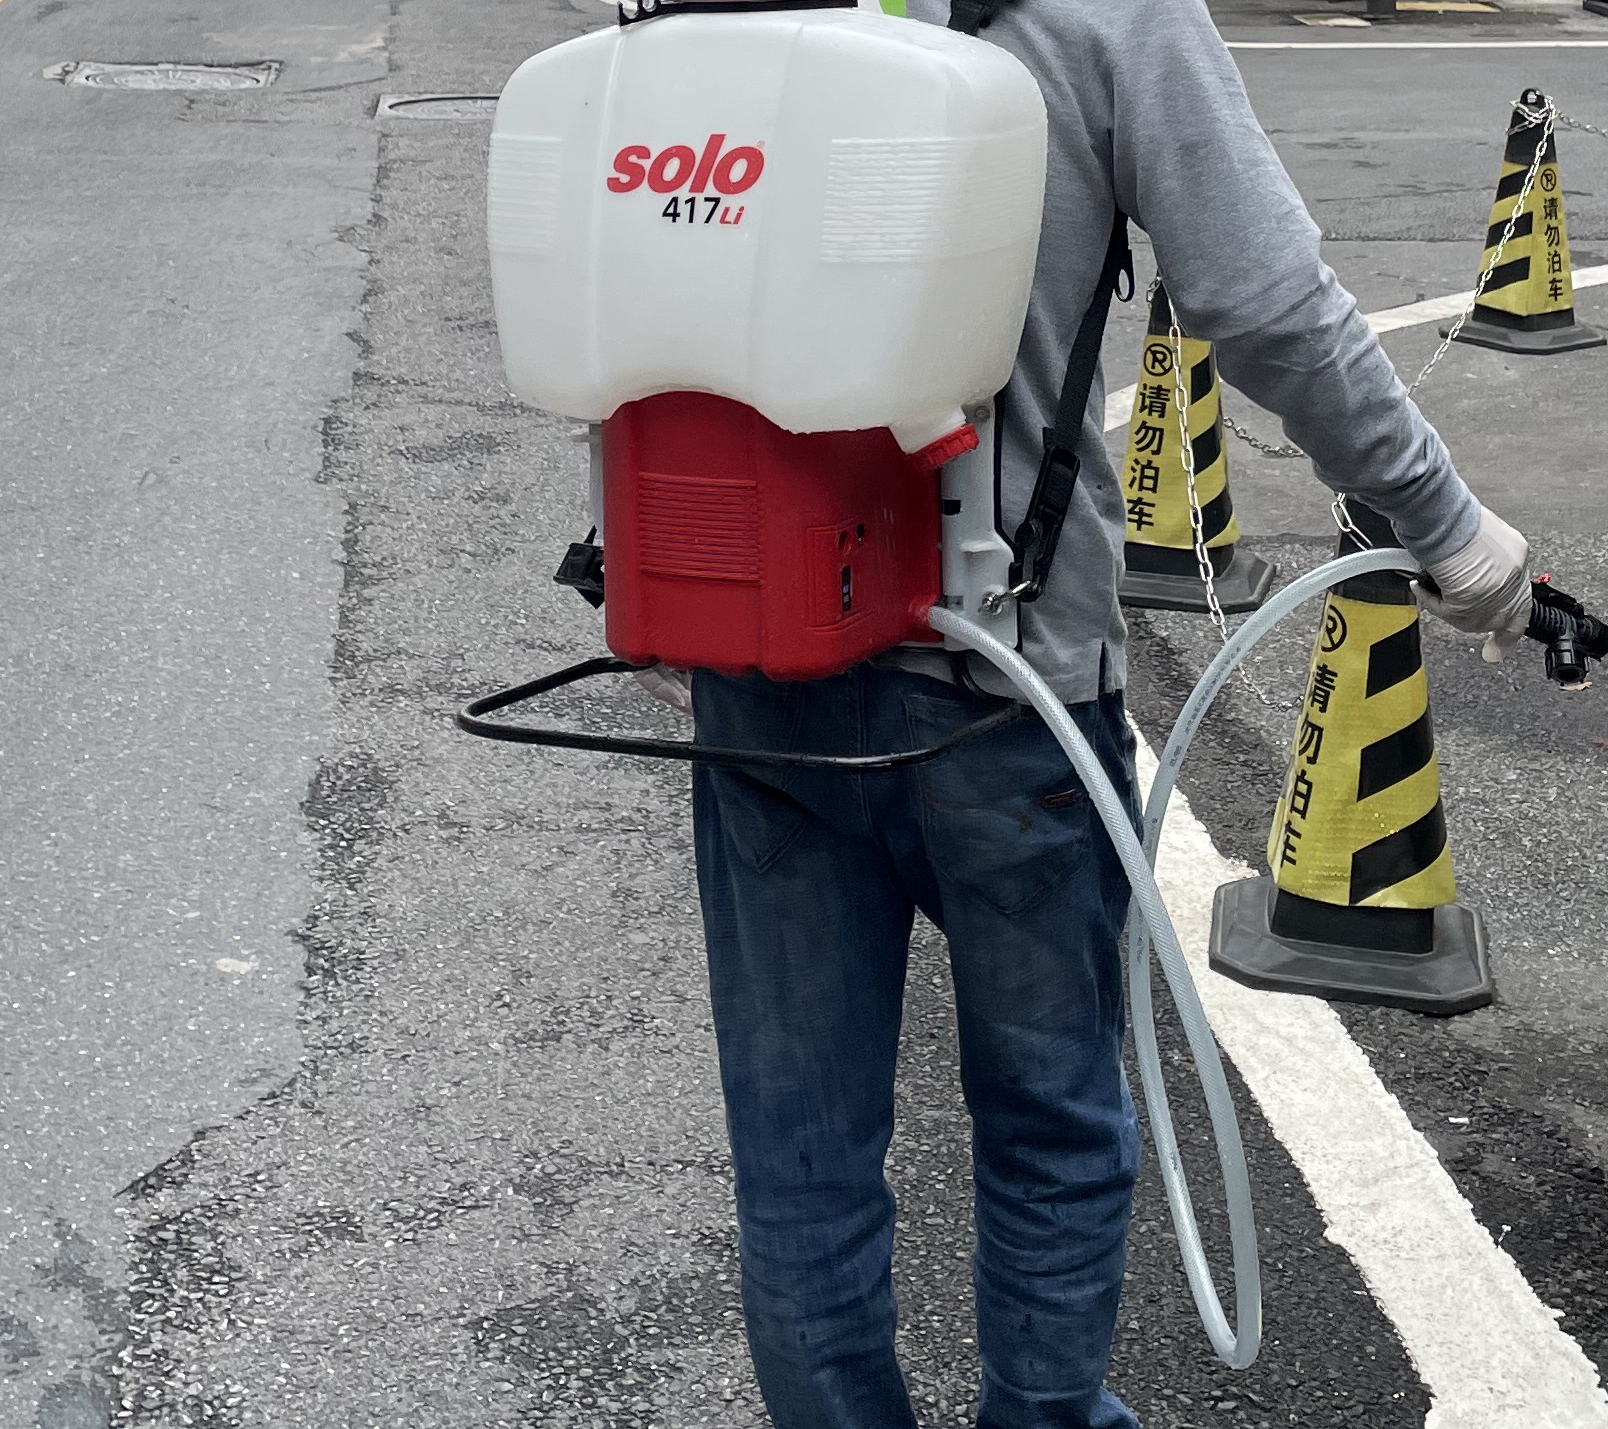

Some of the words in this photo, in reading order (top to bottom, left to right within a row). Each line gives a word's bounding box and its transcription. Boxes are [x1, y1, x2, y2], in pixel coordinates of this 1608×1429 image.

[606, 133, 765, 196] solo
[1543, 197, 1564, 302] 请勿泊车
[1127, 382, 1171, 532] 请勿泊车
